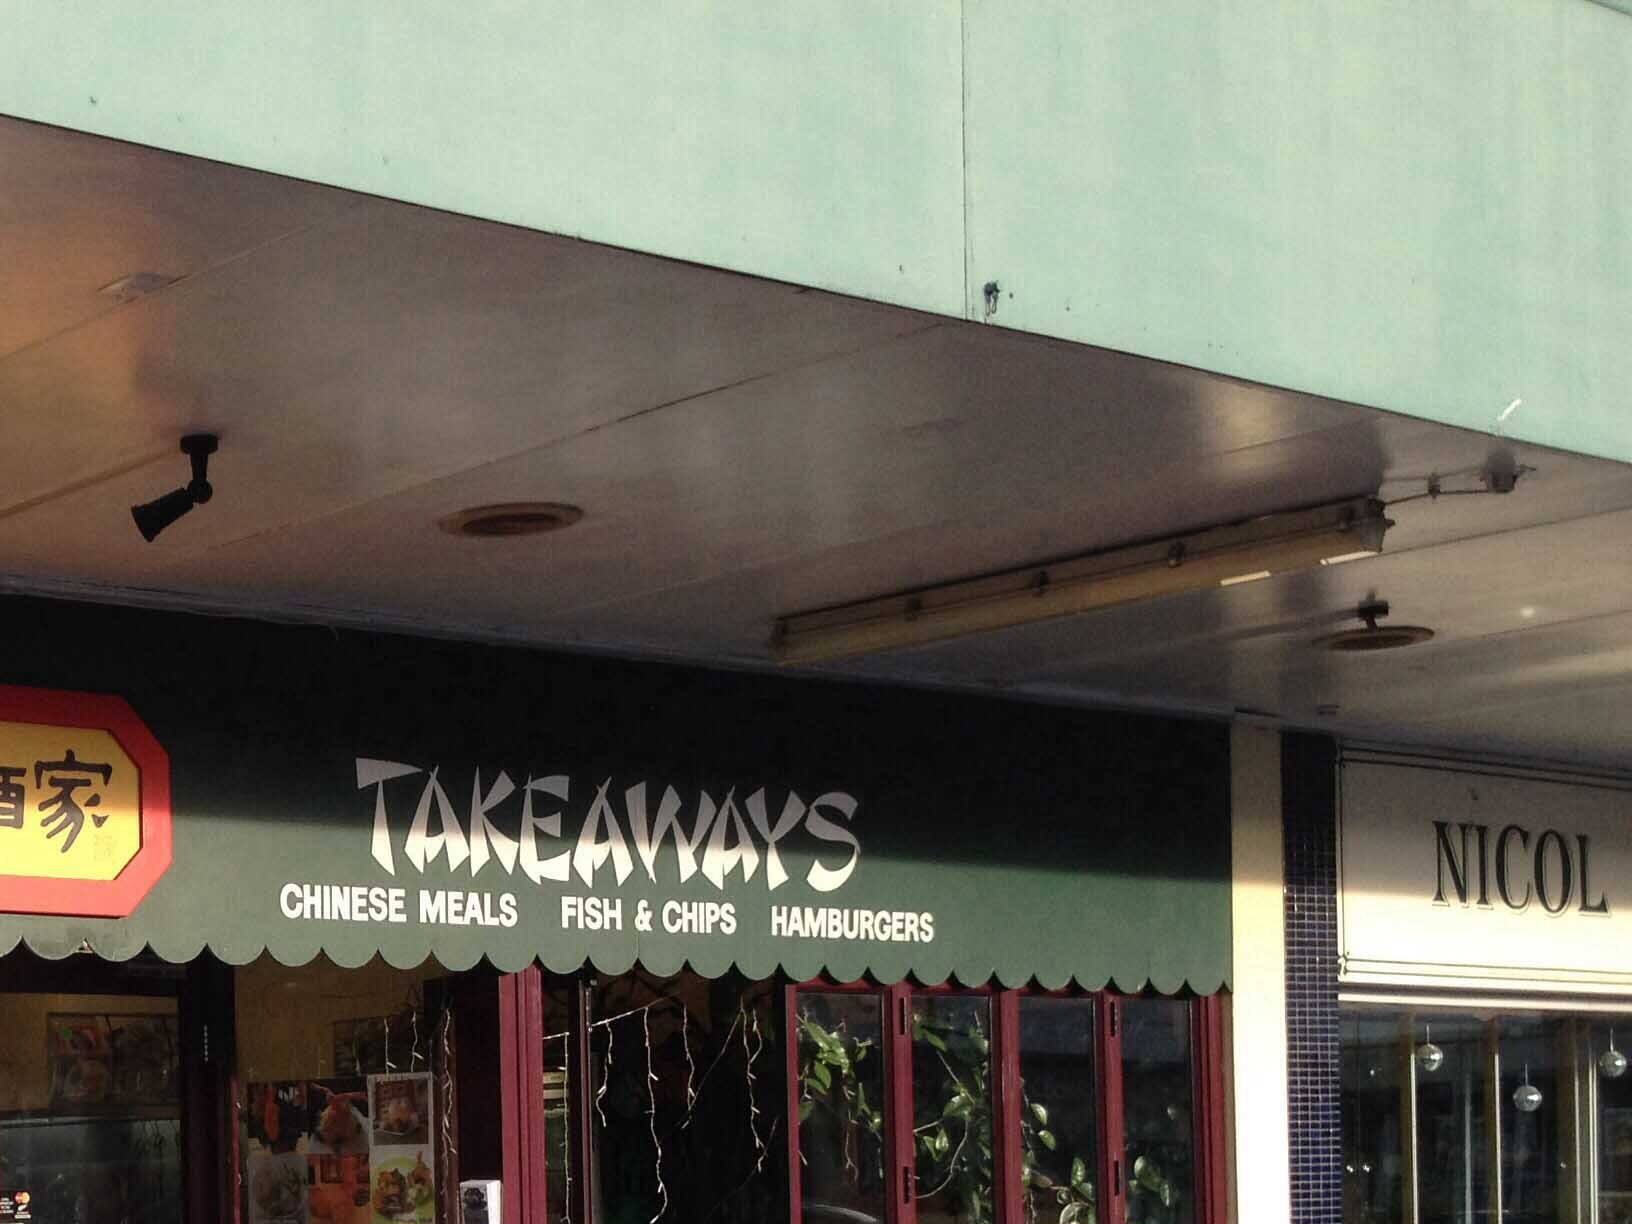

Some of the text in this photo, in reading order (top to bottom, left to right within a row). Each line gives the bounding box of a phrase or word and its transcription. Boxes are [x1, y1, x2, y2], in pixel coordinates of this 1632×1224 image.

[355, 757, 861, 892] TAKEAWAYS
[1431, 820, 1611, 918] NICOL
[280, 883, 934, 943] CHINESE MEALS FISH & CHIPS HAMBURGERS
